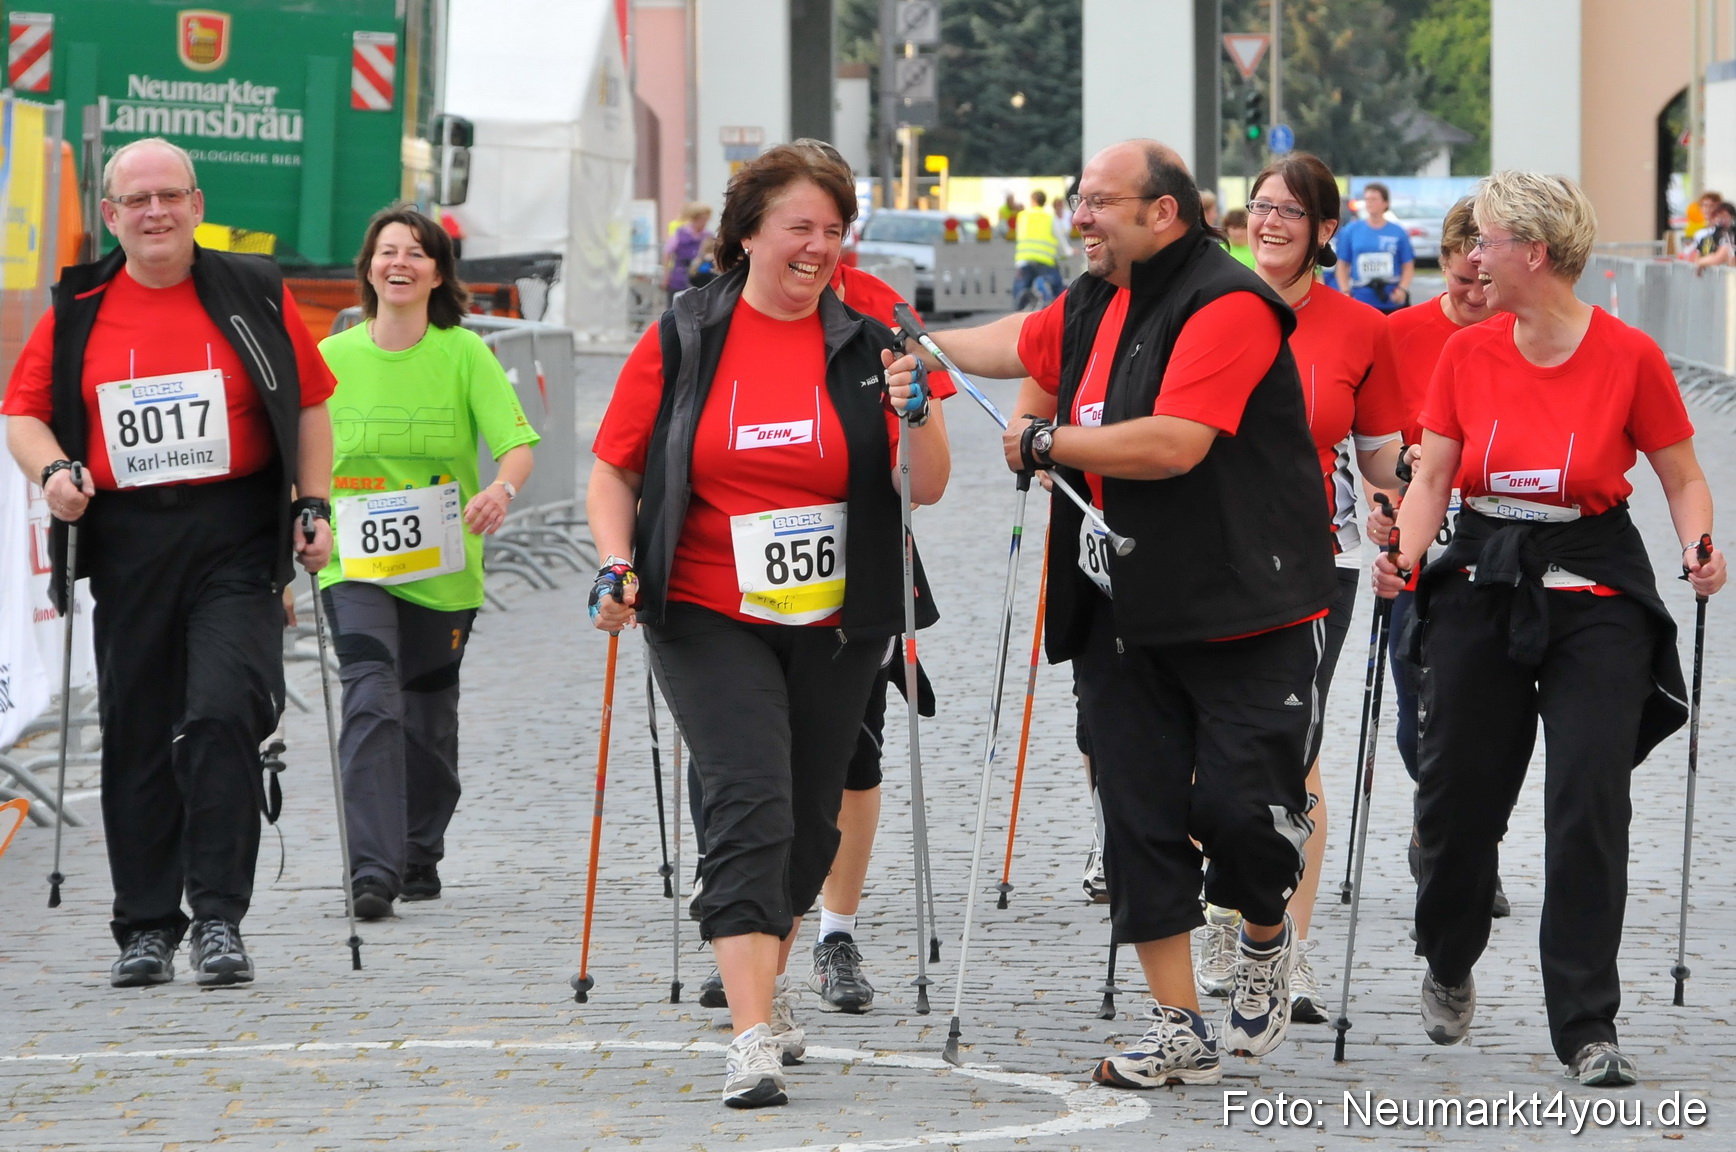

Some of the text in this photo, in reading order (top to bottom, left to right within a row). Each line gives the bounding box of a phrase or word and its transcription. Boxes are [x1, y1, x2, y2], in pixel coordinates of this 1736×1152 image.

[128, 74, 279, 105] Neumarkter
[99, 96, 304, 141] Lammsbräu
[188, 149, 302, 167] OLOGISCHE BIER
[132, 381, 184, 399] BOCK
[1092, 408, 1104, 421] DE
[117, 400, 211, 448] 8017
[333, 405, 456, 454] OPF
[756, 428, 792, 440] DEHN
[127, 448, 214, 473] Karl-Heinz
[334, 476, 387, 490] MERZ
[1509, 477, 1541, 488] DEHN
[366, 496, 408, 510] BOCK
[772, 512, 822, 530] BOCK
[1496, 504, 1549, 521] BOCK
[361, 515, 423, 554] 853
[764, 535, 836, 585] 856
